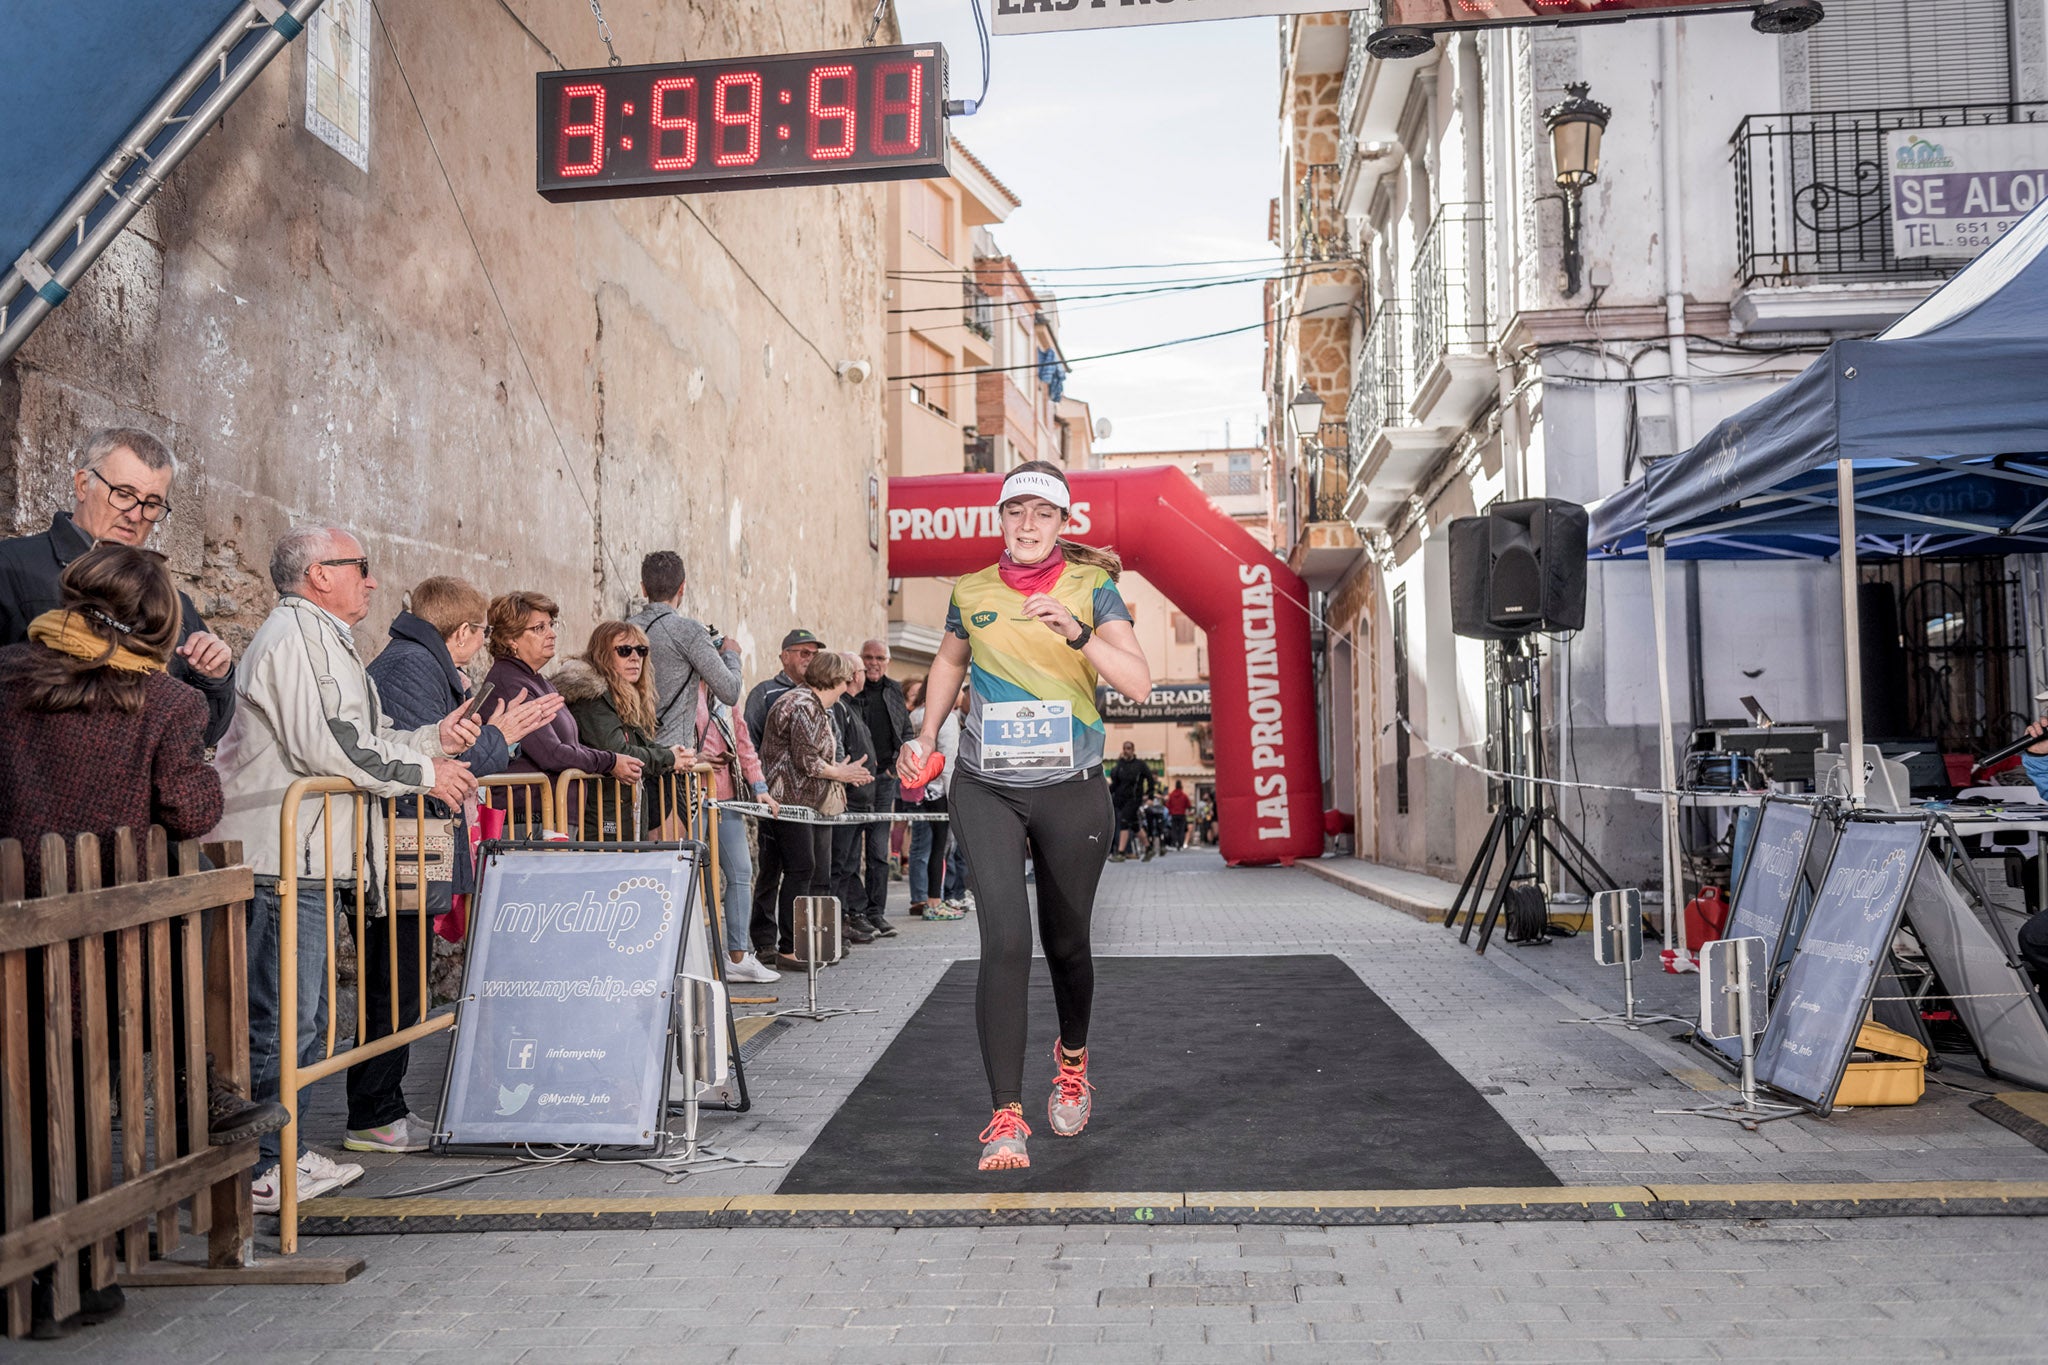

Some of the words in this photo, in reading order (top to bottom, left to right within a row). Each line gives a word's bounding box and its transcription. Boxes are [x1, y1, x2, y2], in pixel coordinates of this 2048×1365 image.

[561, 62, 922, 177] 3:59:51
[1901, 178, 1946, 215] SE
[1956, 222, 1988, 233] 651
[1957, 236, 1991, 247] 964
[1015, 476, 1050, 487] WOMAN
[889, 502, 1091, 541] PROVIS
[1239, 564, 1286, 769] PROVINCIAS
[1105, 706, 1139, 717] bebida
[1141, 708, 1163, 718] para
[1001, 721, 1053, 738] 1314
[1254, 774, 1291, 840] LAS
[494, 890, 641, 943] mychip
[482, 976, 657, 1002] www.mychip.es
[546, 1048, 606, 1060] /infomychip
[538, 1093, 611, 1106] @Mychip_Info
